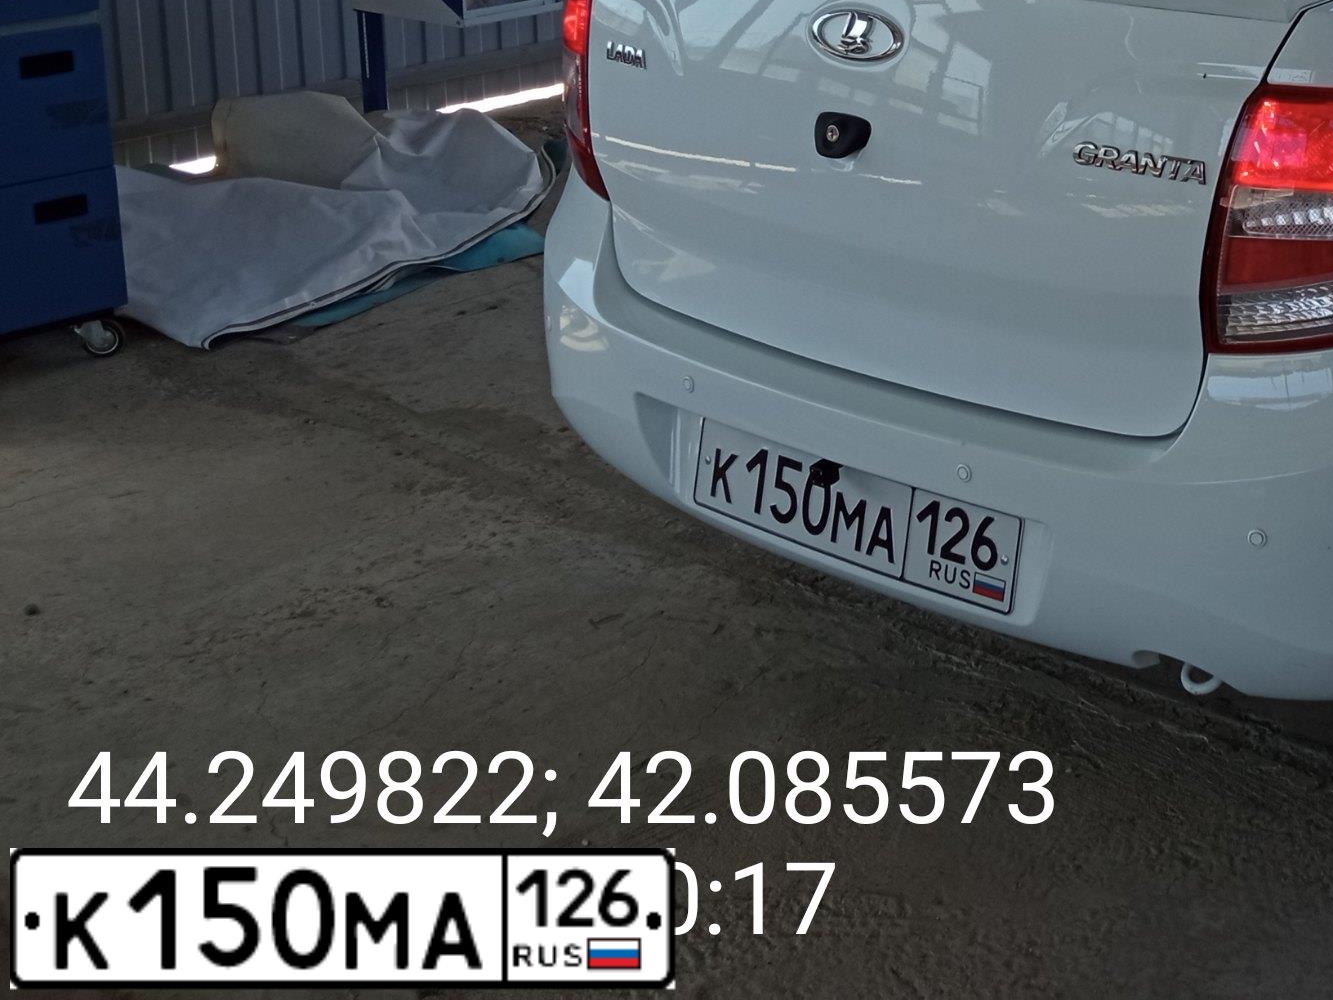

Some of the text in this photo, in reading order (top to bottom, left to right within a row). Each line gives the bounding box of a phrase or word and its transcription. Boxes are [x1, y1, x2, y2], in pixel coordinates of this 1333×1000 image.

[606, 41, 648, 70] LADA
[1072, 141, 1207, 186] GRANTA
[915, 499, 999, 572] 126
[928, 561, 971, 590] RUS
